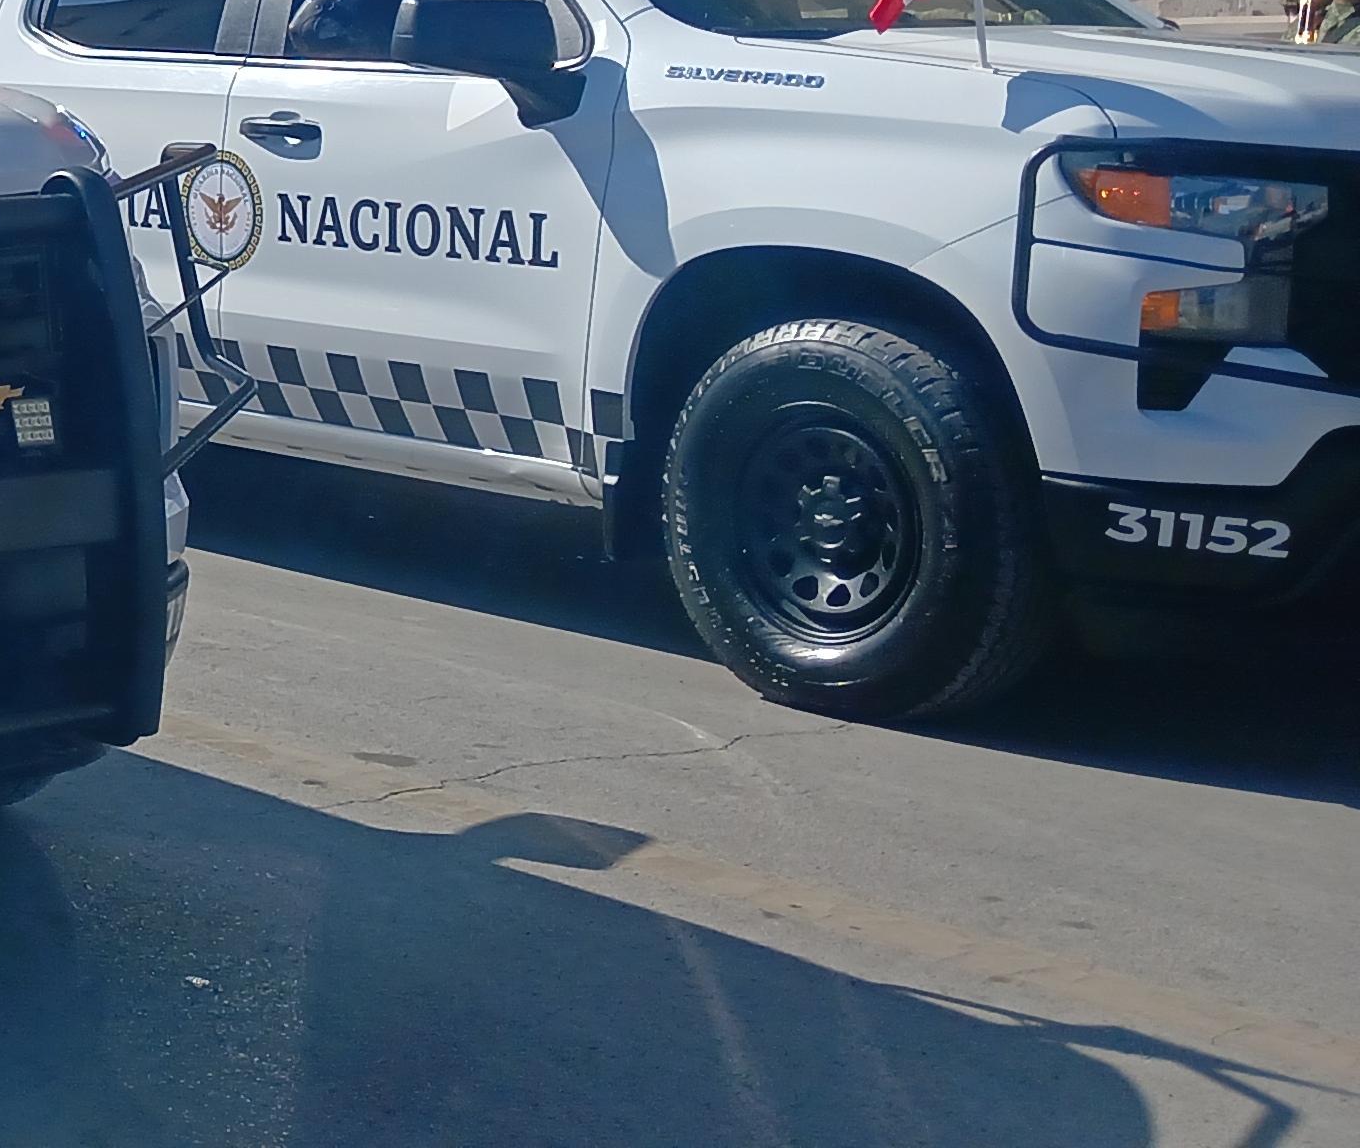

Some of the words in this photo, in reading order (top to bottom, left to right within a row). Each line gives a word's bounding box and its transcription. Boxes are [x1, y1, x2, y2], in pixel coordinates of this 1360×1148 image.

[665, 65, 826, 89] SILVERADO
[277, 193, 559, 269] NACIONAL
[1104, 502, 1291, 559] 31152
